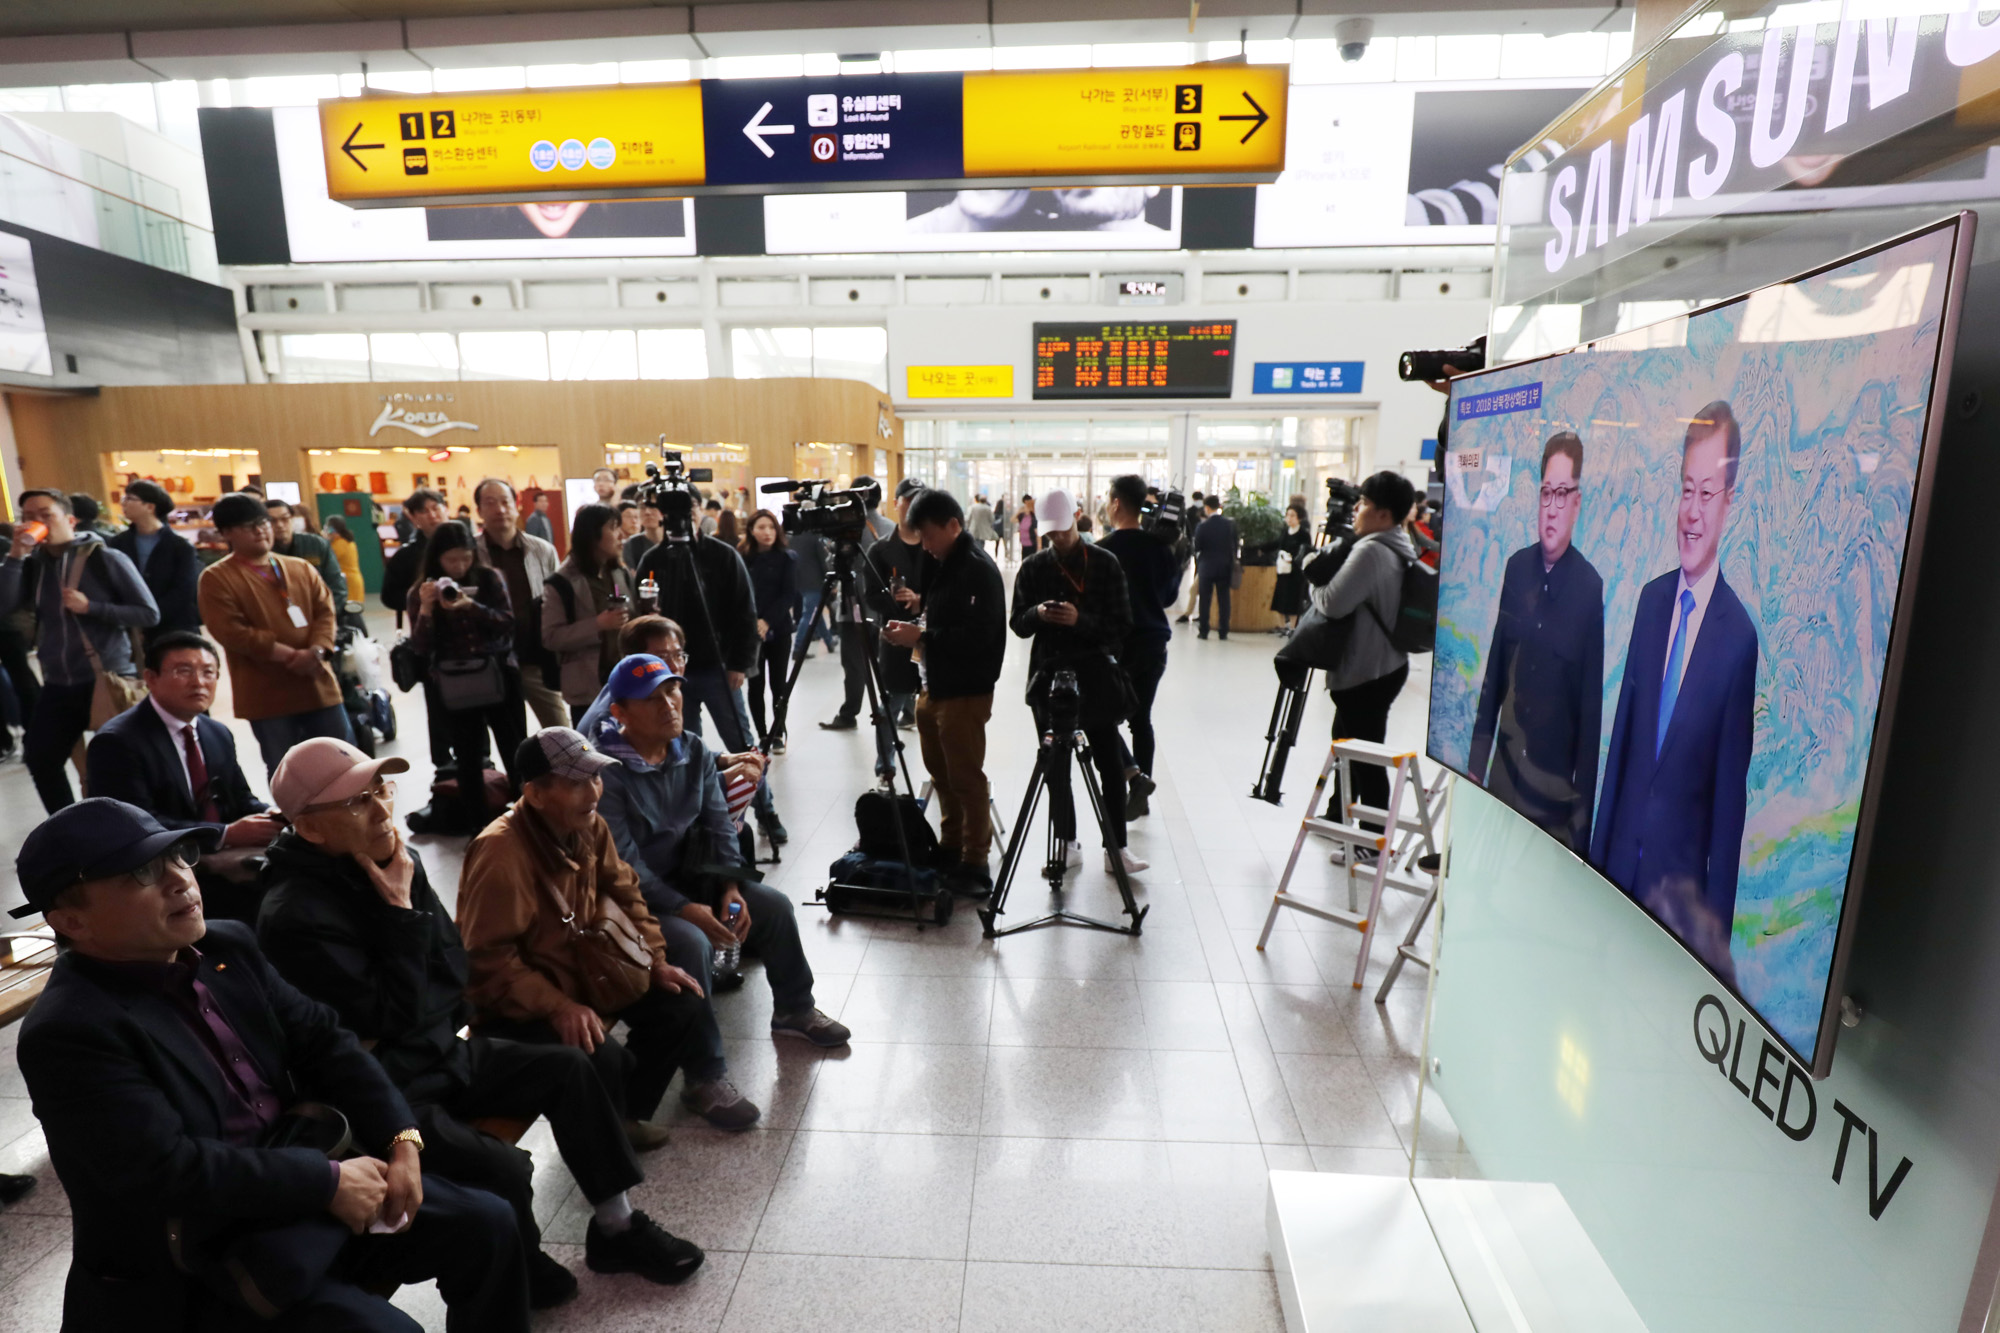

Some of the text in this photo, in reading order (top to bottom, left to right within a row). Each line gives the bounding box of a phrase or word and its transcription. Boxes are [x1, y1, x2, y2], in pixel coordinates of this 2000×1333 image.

[1081, 87, 1197, 111] 나가는 곳(서부) 3
[407, 116, 417, 138] 1
[436, 114, 451, 136] 2
[461, 111, 493, 125] 나가는
[1120, 124, 1167, 139] 공항철도
[433, 146, 498, 160] 버스환승센터
[621, 141, 653, 155] 지하철
[922, 371, 957, 386] 나오는
[1460, 386, 1540, 416] 특보 2018 남북정상회담 1부
[1694, 994, 1913, 1221] QLED TV
